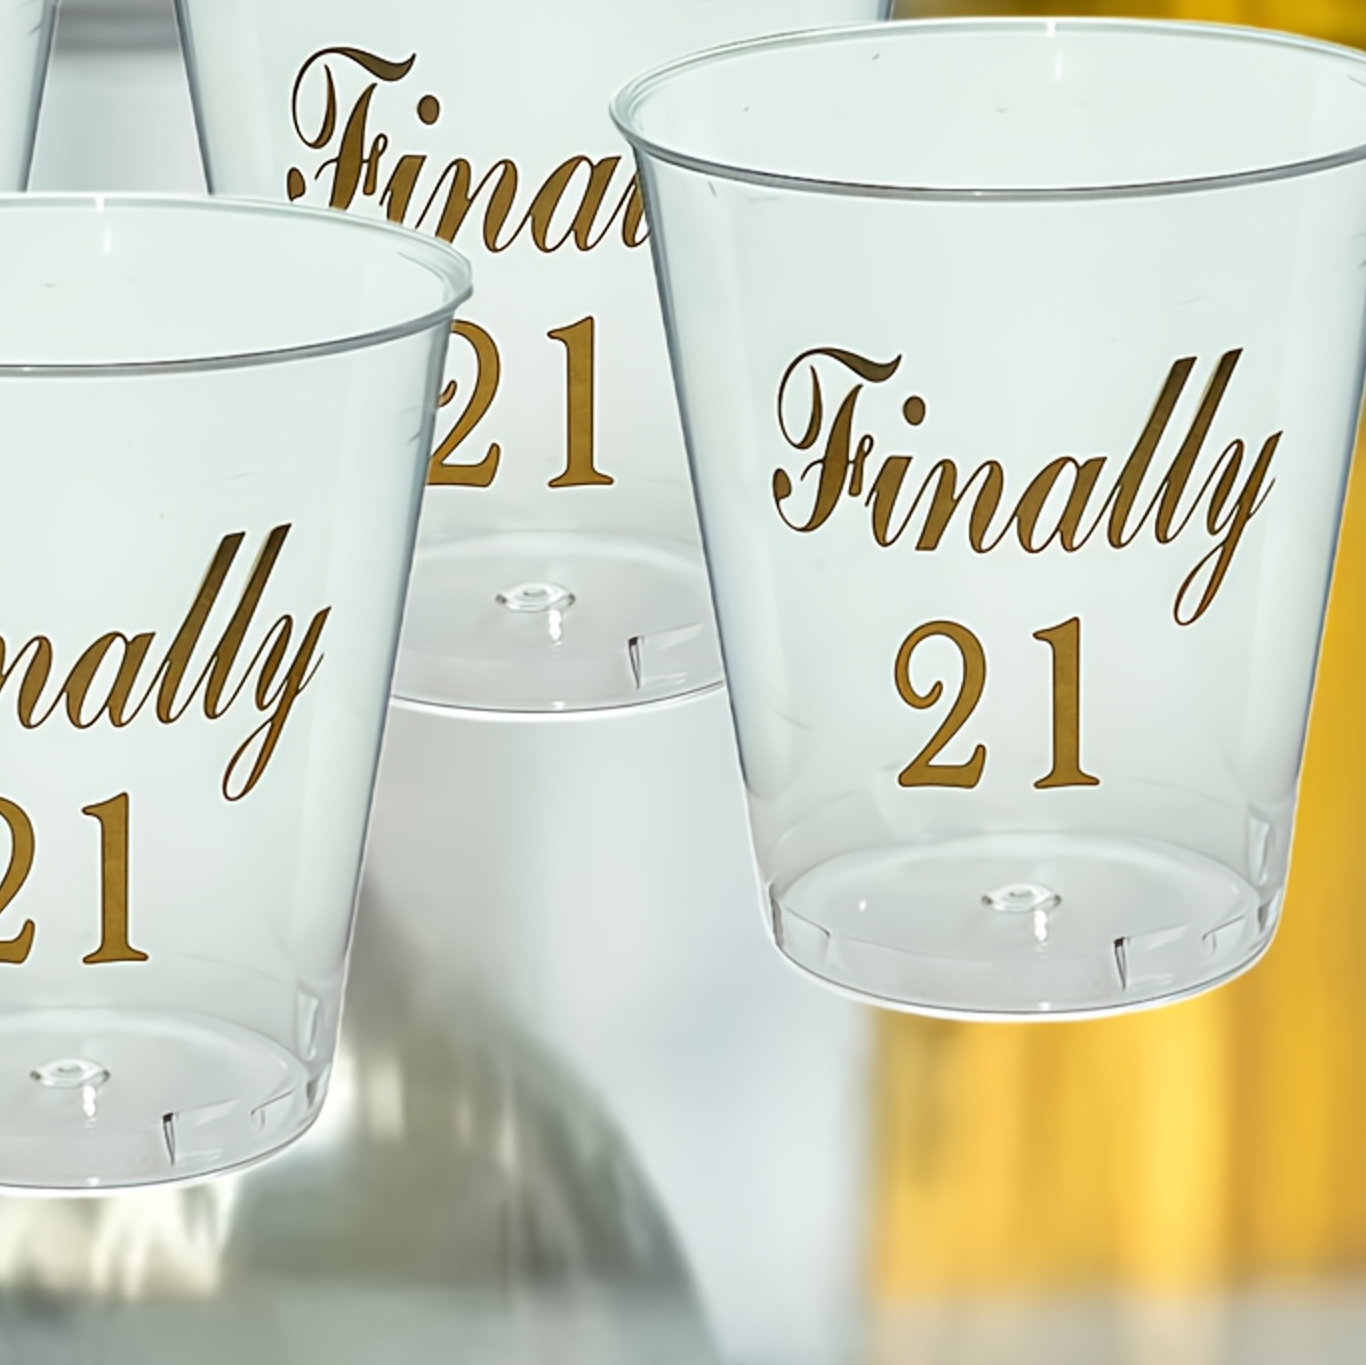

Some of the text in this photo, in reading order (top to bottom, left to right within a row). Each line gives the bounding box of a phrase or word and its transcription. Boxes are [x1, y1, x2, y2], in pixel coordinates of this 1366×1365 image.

[286, 47, 649, 253] Fina
[425, 316, 615, 489] 21
[772, 348, 1283, 626] Finally
[894, 616, 1100, 790] 21
